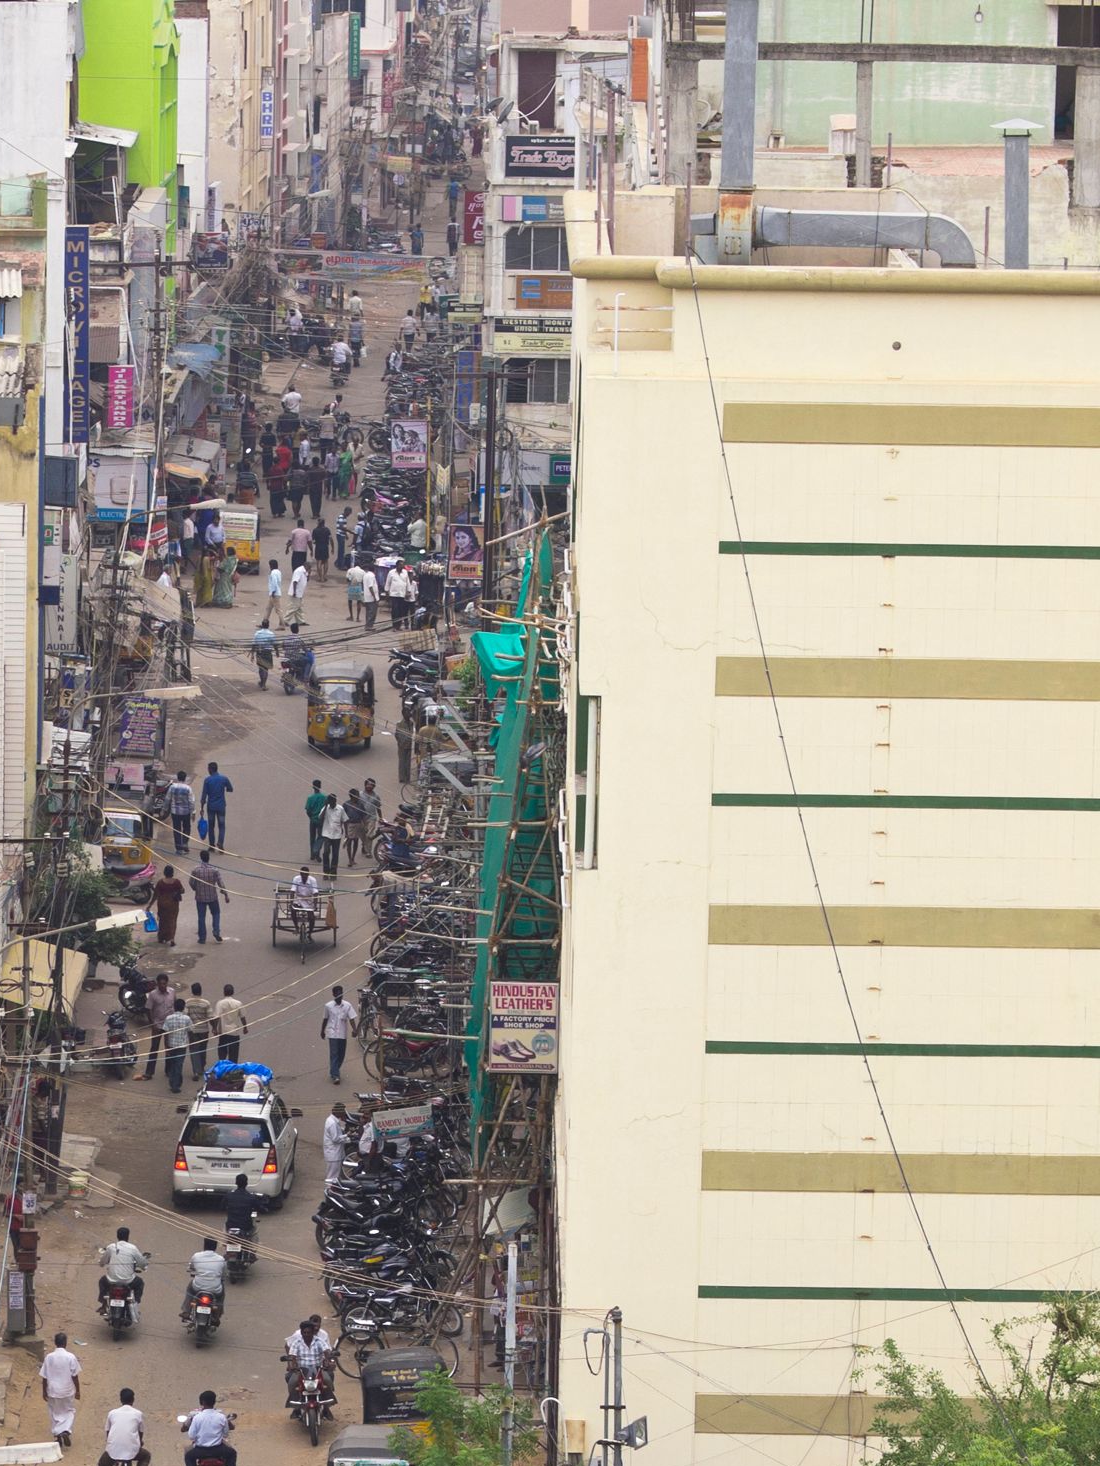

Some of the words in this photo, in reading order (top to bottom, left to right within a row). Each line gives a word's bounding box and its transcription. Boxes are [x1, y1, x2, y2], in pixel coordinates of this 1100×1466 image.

[511, 150, 542, 164] Trade
[544, 319, 572, 327] MONEY
[113, 368, 126, 427] JIGARTHANDA
[492, 985, 556, 998] HINDUSTAN
[495, 998, 553, 1011] LEATHER'S
